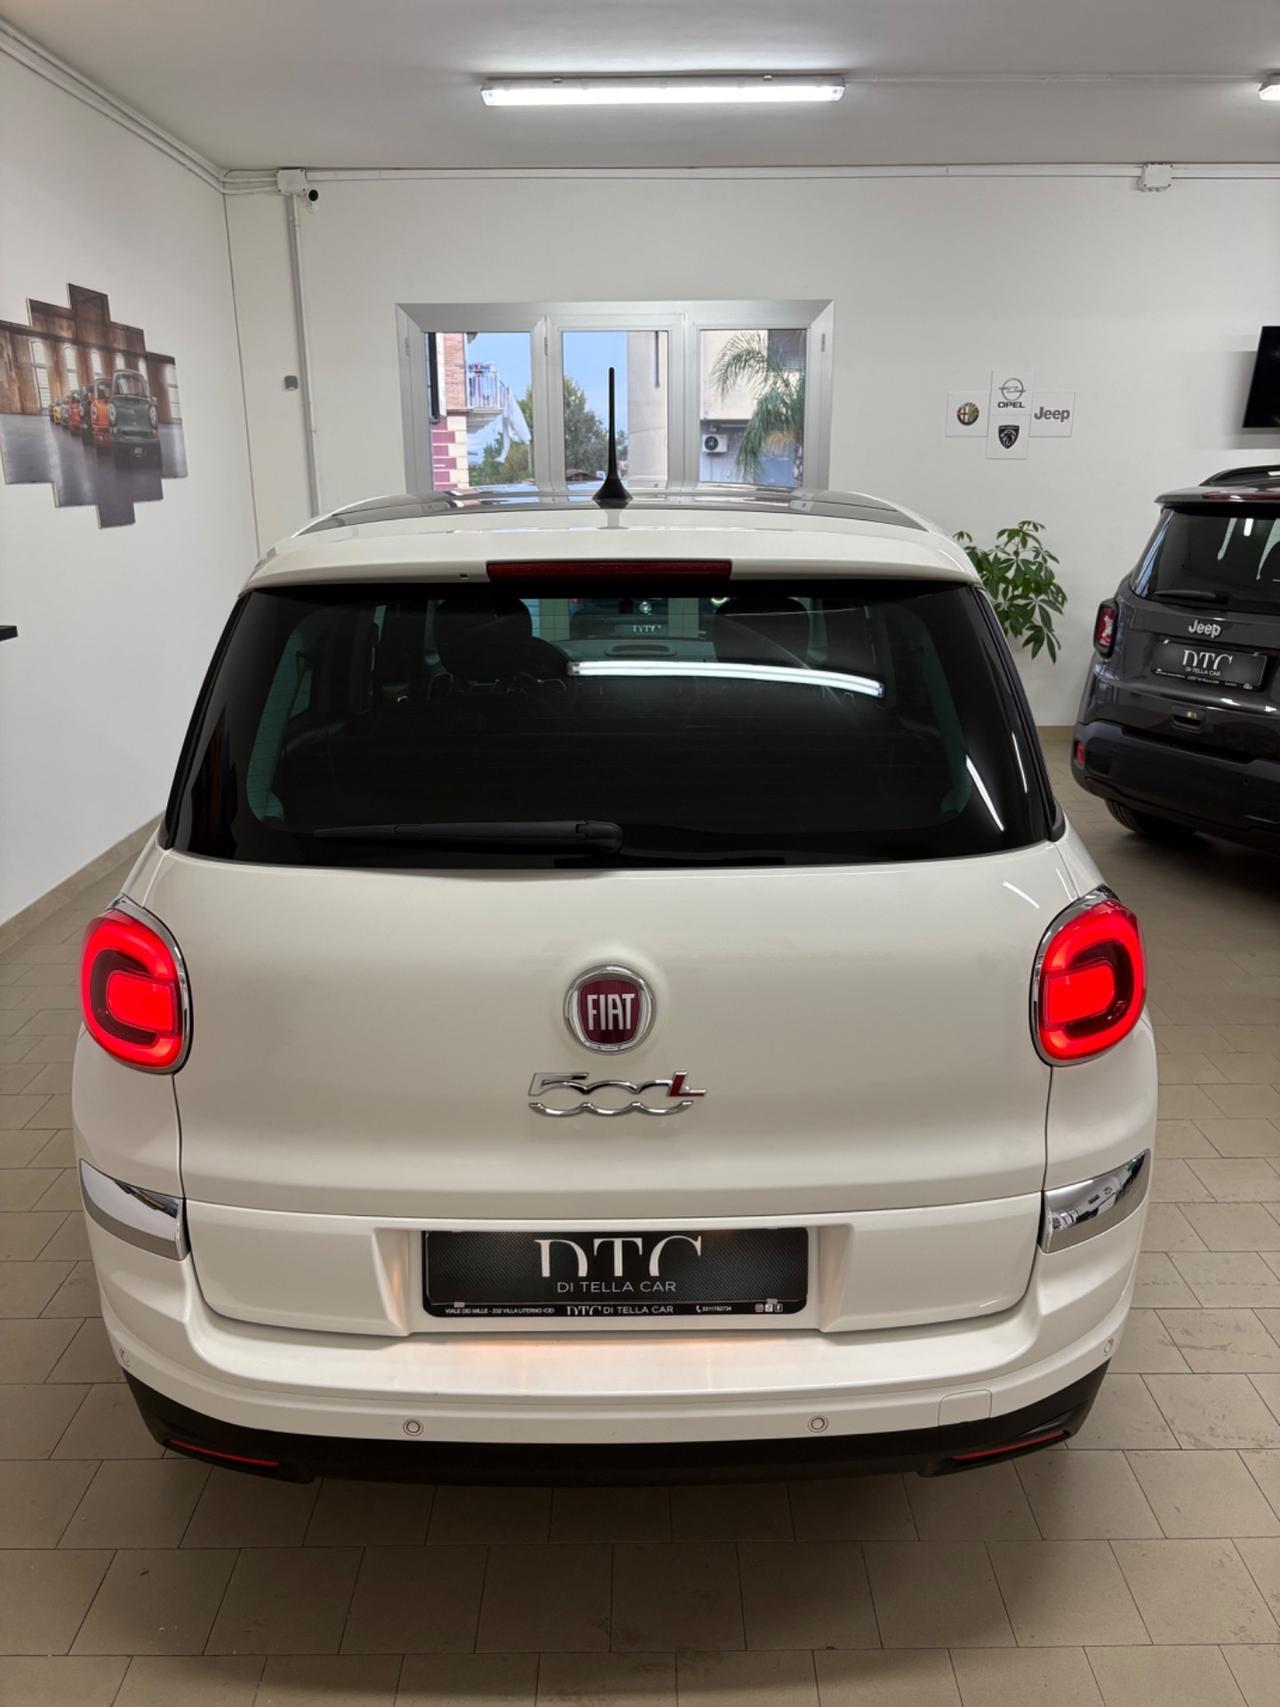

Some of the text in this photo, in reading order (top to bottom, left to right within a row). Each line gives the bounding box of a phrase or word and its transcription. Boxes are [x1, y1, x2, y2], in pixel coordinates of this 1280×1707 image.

[997, 401, 1025, 409] OPEL
[1034, 406, 1071, 422] Jeep
[1188, 619, 1222, 638] Jeep
[1182, 649, 1233, 670] DTC
[586, 993, 636, 1031] FIAT
[528, 1071, 707, 1117] 500L
[534, 1235, 702, 1278] DTC
[557, 1280, 677, 1293] DI TELLA CAR
[566, 1305, 674, 1316] DTC DI TELLA CAR
